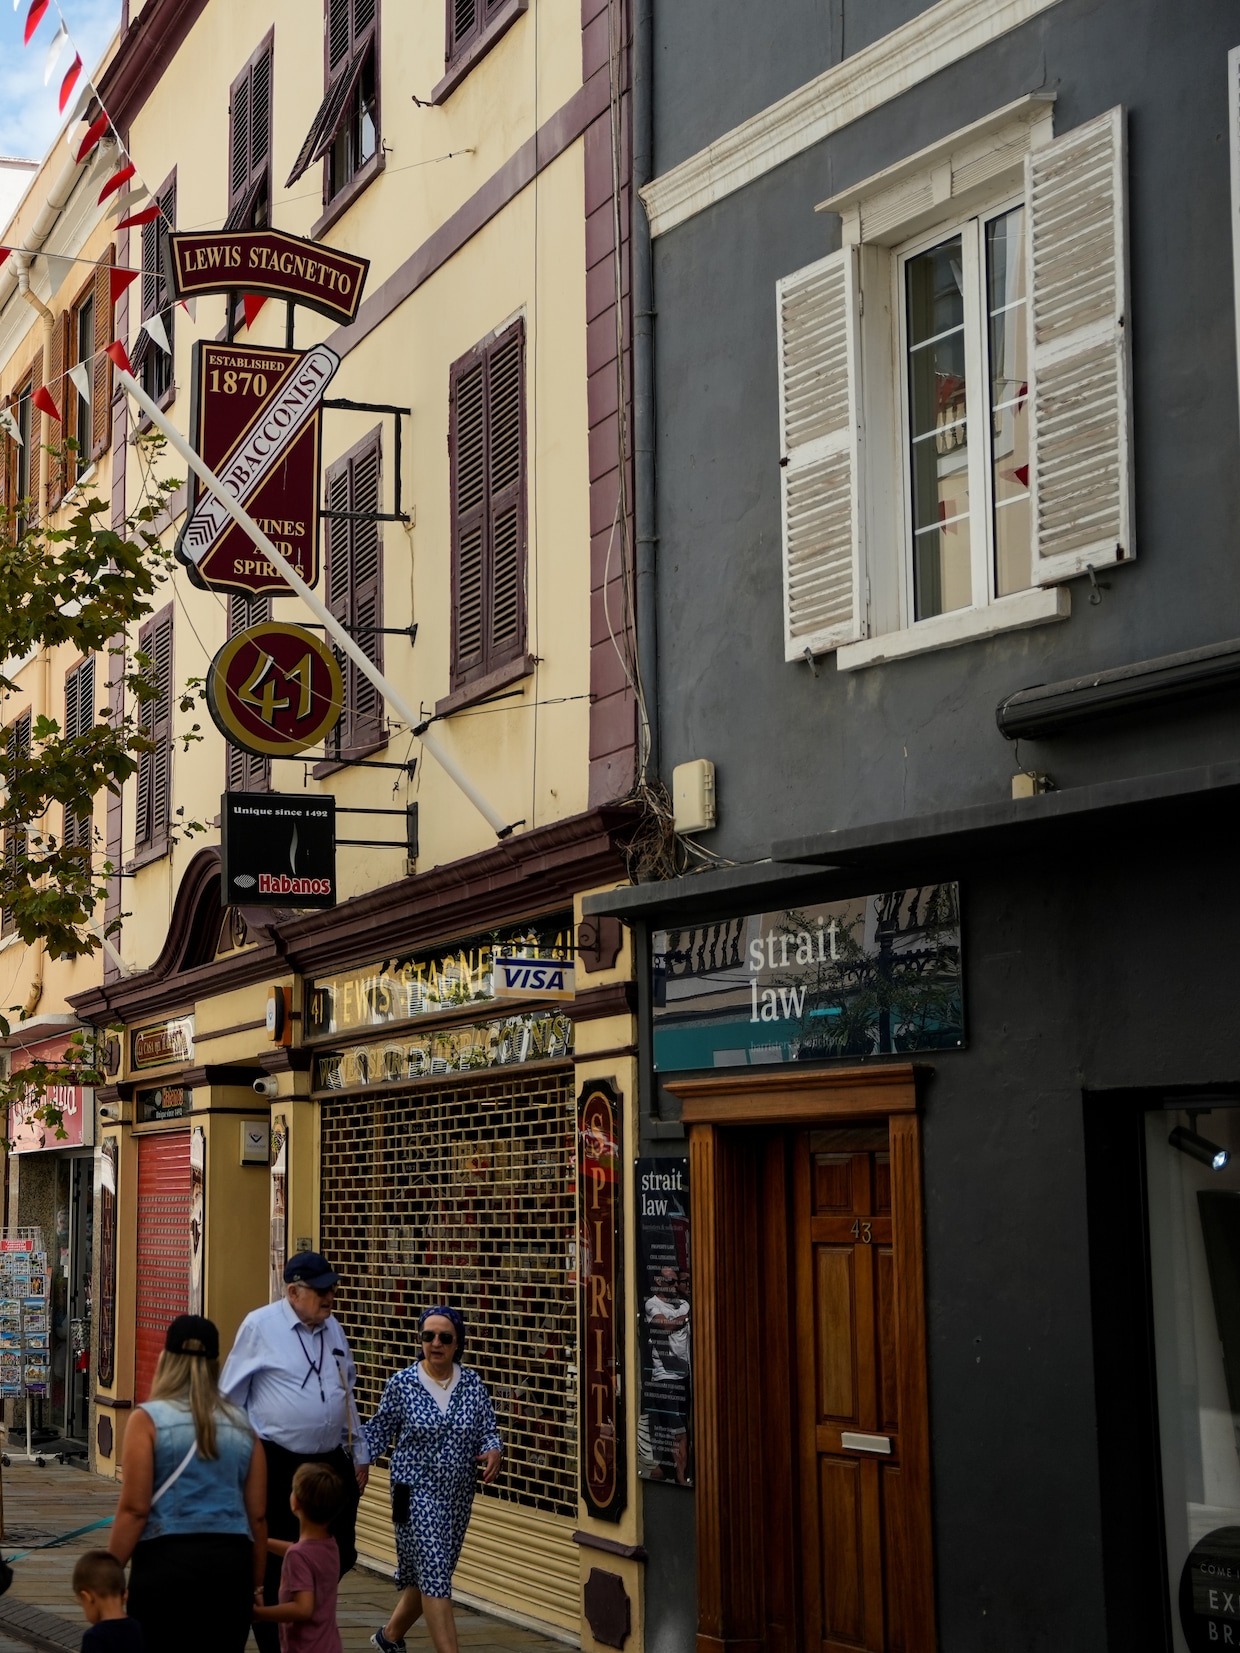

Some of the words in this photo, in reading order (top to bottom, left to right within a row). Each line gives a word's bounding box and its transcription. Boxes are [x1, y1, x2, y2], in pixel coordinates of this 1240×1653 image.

[184, 246, 242, 273] LEWIS
[248, 247, 351, 296] STAGNETTO
[209, 355, 285, 372] ESTABLISHED
[209, 370, 267, 397] 1870
[238, 652, 312, 724] 41
[233, 807, 273, 816] Unique
[275, 809, 302, 817] since
[258, 873, 331, 895] Habanos
[748, 919, 841, 973] strait
[503, 967, 564, 990] VISA
[311, 992, 323, 1025] 41
[333, 977, 391, 1027] LEWIS
[749, 980, 806, 1025] law
[641, 1167, 683, 1191] strait
[641, 1193, 669, 1216] law
[850, 1218, 873, 1245] 43
[589, 1111, 612, 1486] SPIRITS
[1200, 1563, 1232, 1578] COME
[1208, 1589, 1240, 1613] EX
[1208, 1620, 1240, 1646] BR
